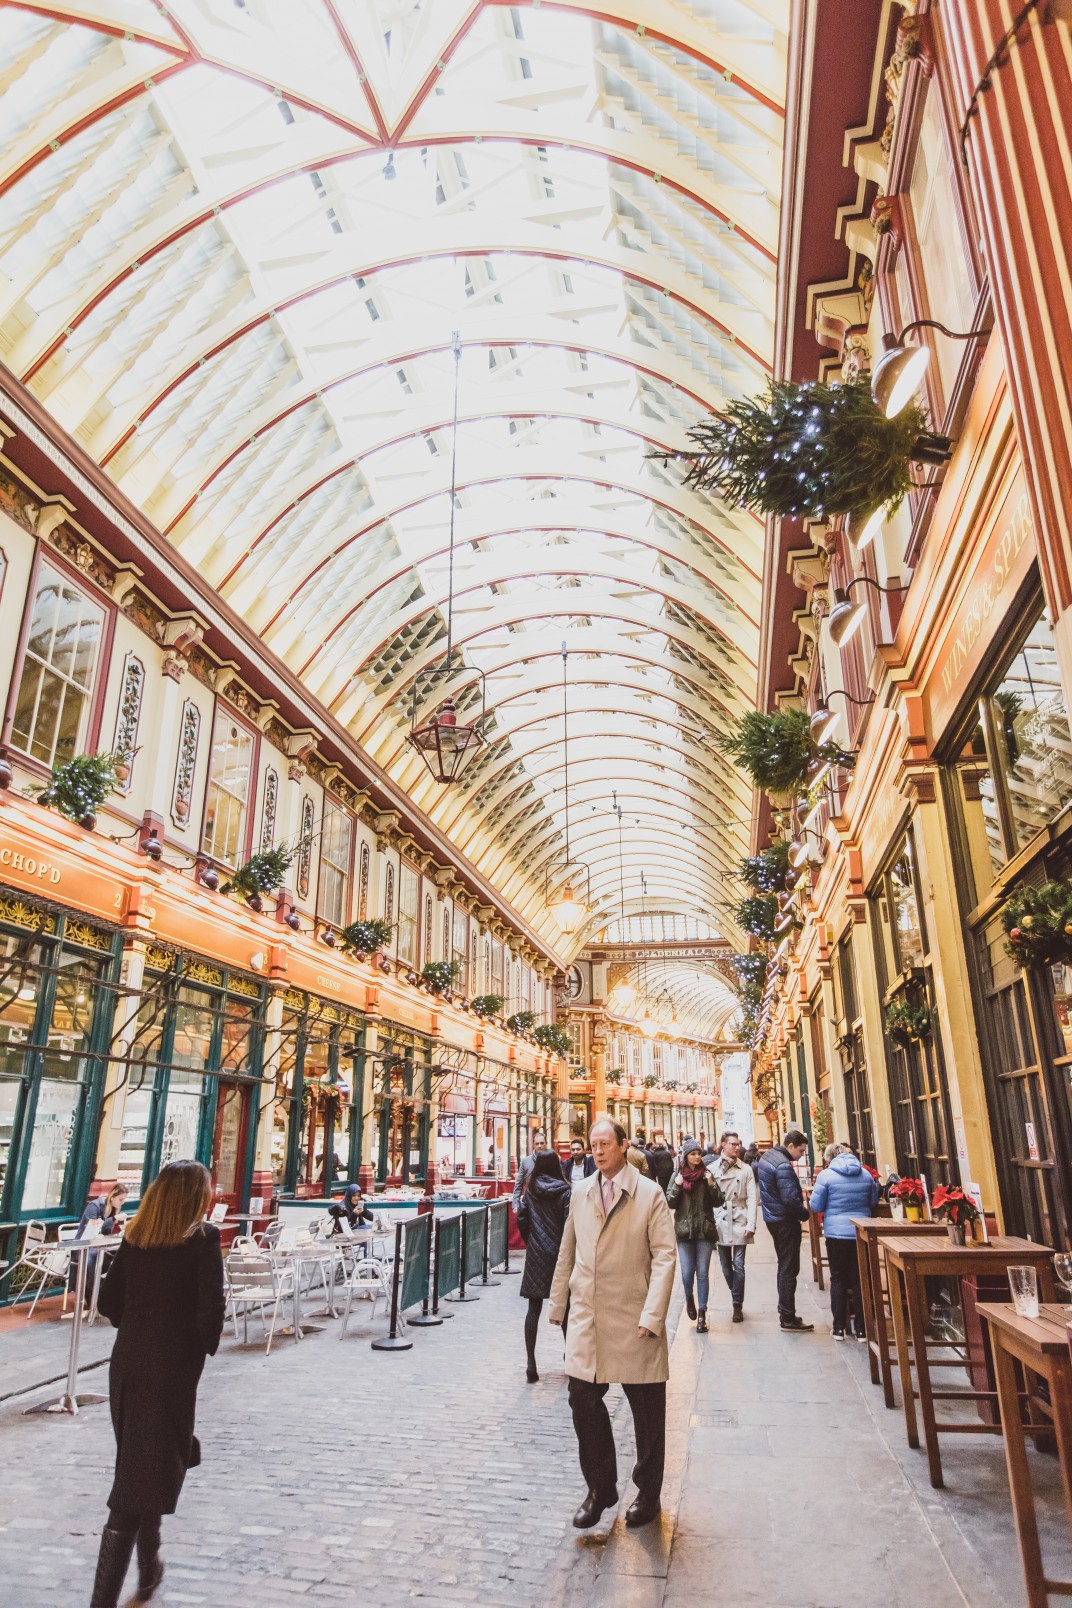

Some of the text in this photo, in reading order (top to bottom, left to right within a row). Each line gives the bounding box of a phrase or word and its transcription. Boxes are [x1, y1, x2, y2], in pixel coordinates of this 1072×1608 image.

[941, 603, 982, 694] WINES
[981, 581, 996, 619] &
[0, 848, 61, 884] CHOP'D
[114, 893, 122, 909] 2
[317, 975, 341, 993] CHEESE
